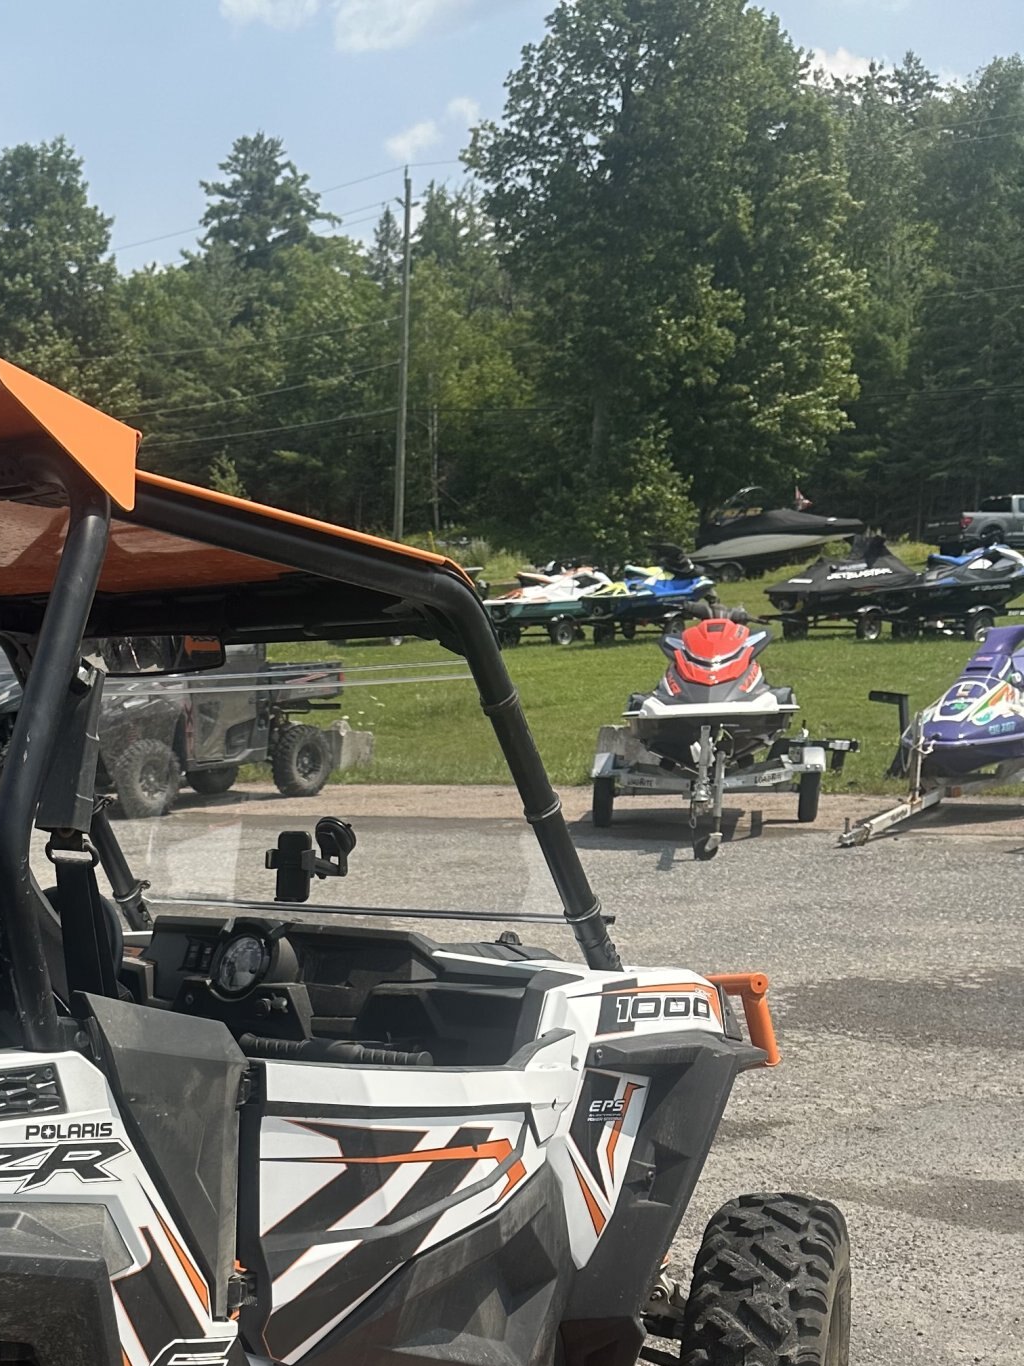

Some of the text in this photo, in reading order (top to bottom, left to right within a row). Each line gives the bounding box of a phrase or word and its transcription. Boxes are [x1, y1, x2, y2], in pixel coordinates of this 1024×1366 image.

[616, 994, 711, 1023] 1000
[589, 1099, 625, 1112] EPS
[25, 1122, 113, 1140] POLARIS
